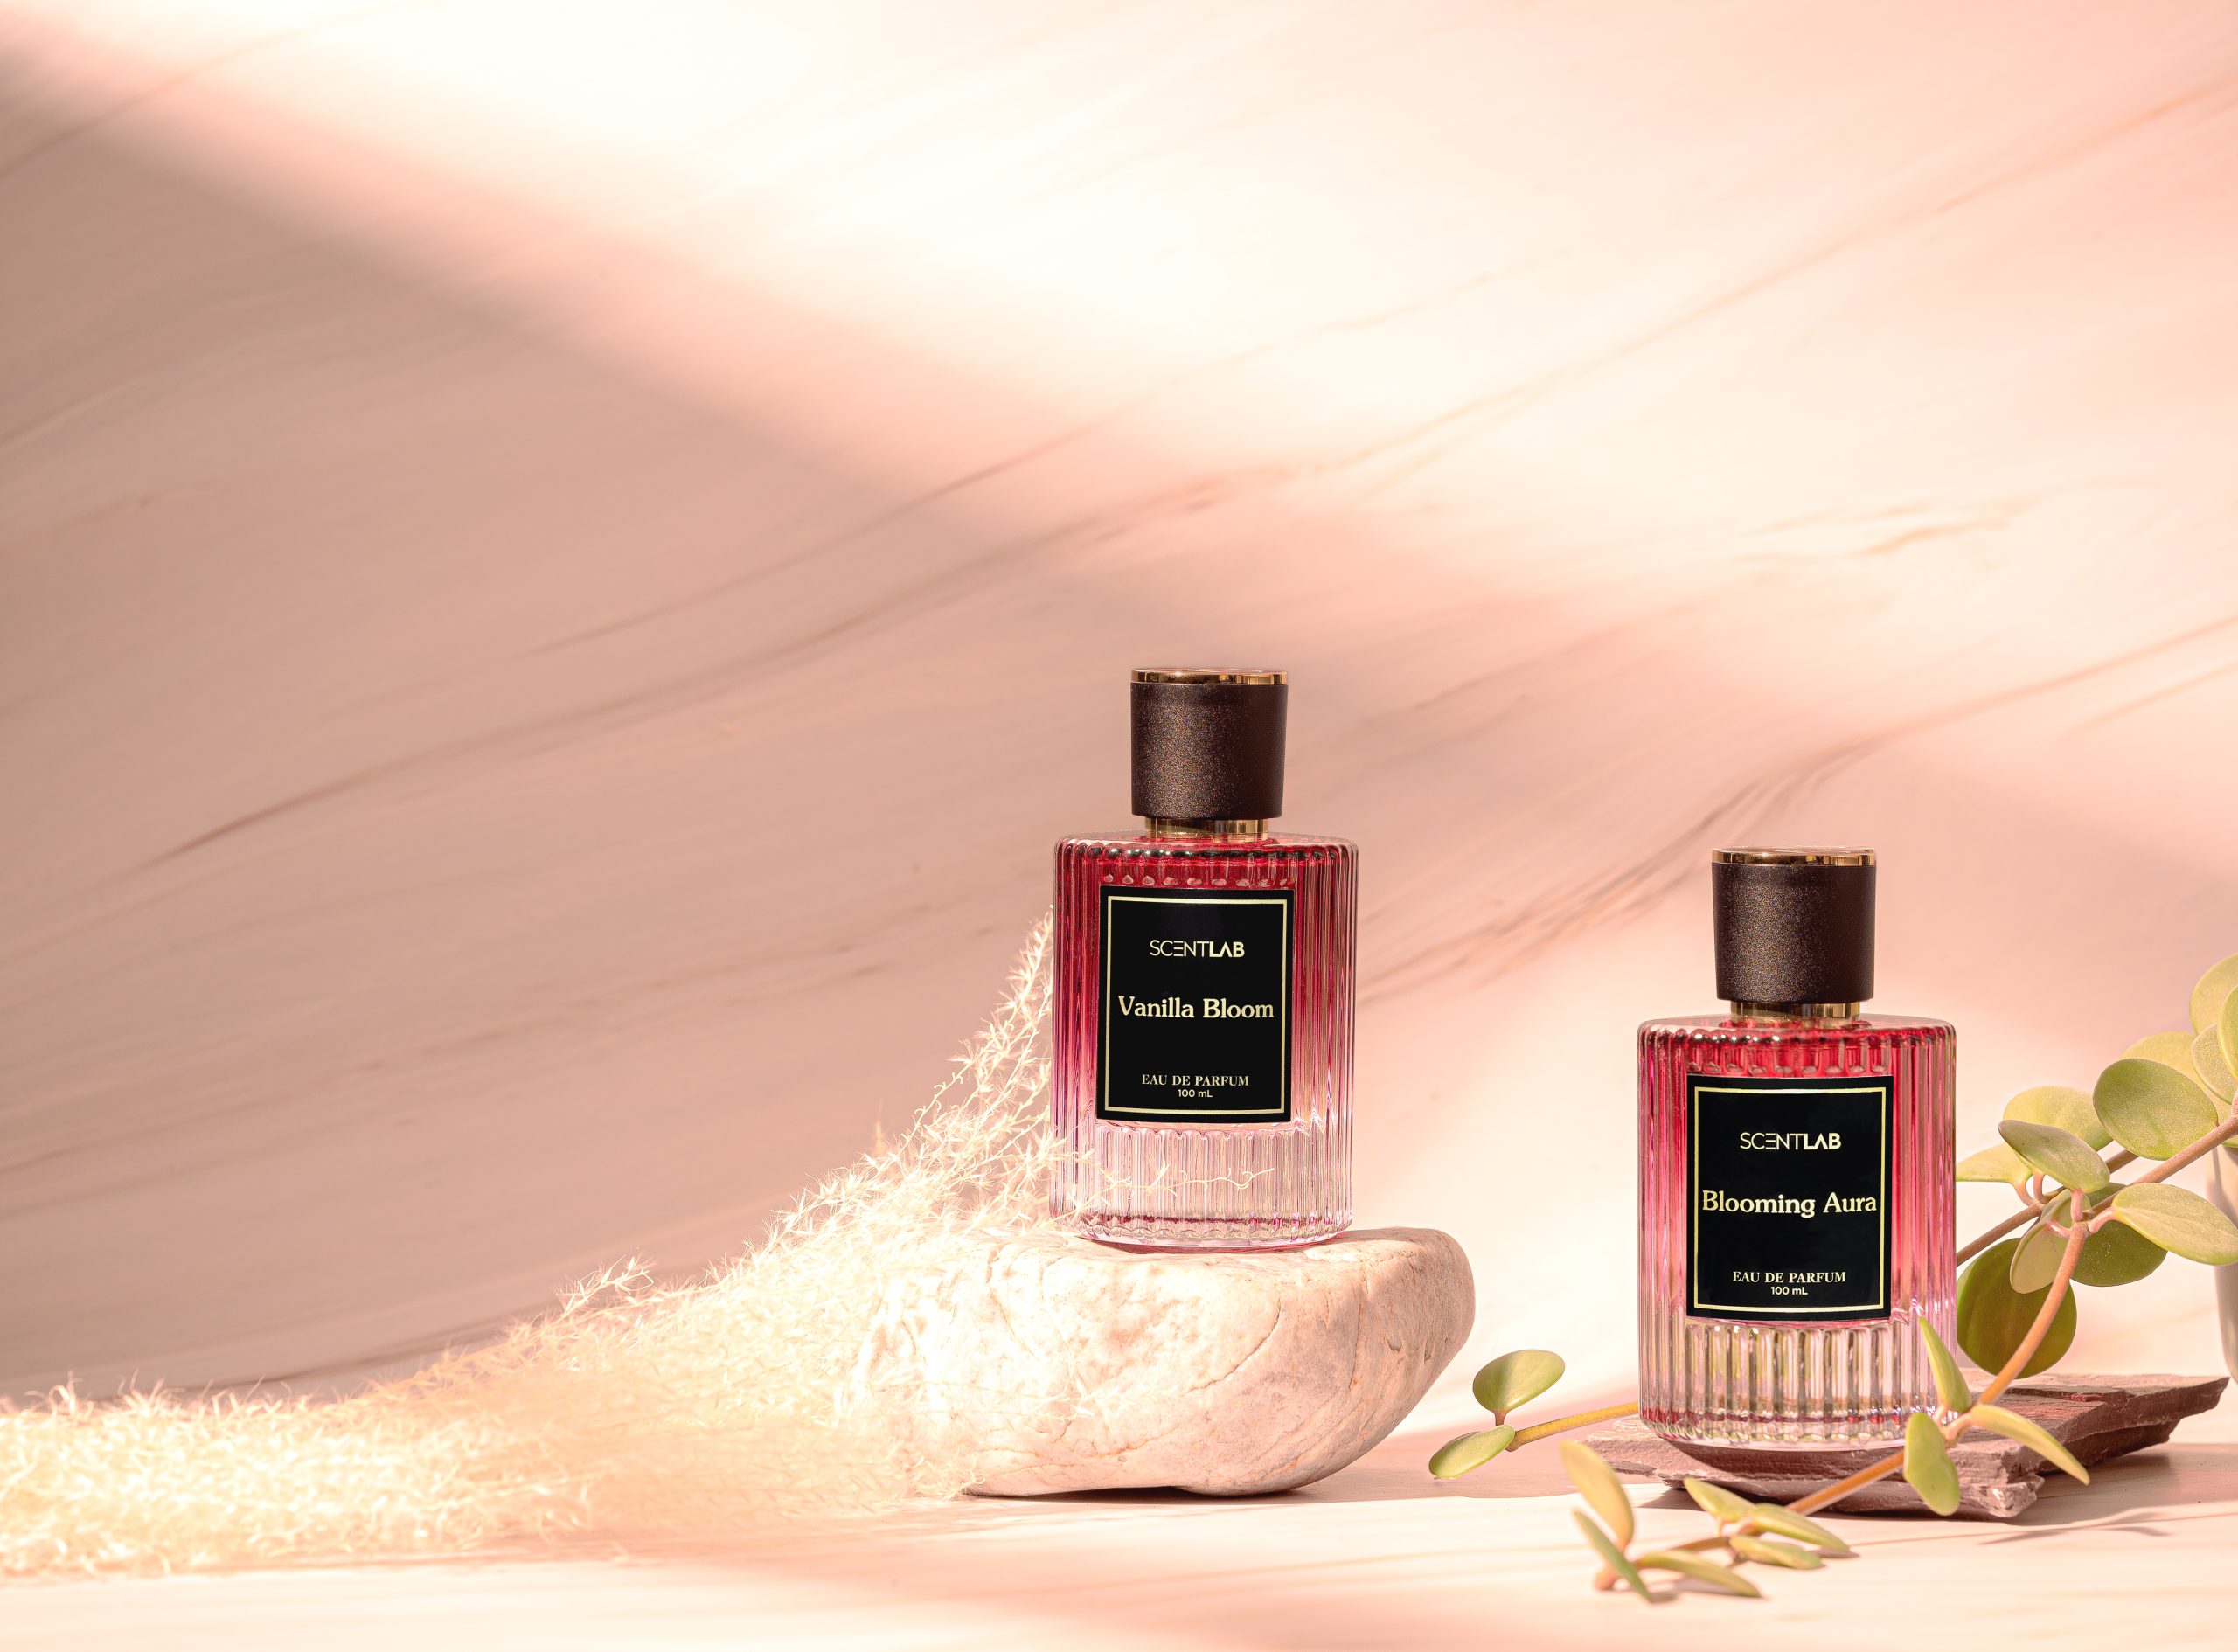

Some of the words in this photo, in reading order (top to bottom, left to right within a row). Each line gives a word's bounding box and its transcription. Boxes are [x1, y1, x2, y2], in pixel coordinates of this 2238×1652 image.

[1149, 939, 1246, 958] SCENTLAB
[1118, 995, 1195, 1018] Vanilla
[1202, 997, 1275, 1019] Bloom
[1141, 1073, 1168, 1086] EAU
[1171, 1074, 1191, 1086] DE
[1194, 1075, 1249, 1086] PARFUM
[1177, 1088, 1196, 1098] 100
[1198, 1089, 1213, 1098] mL
[1740, 1131, 1842, 1150] SCENTLAB
[1702, 1190, 1816, 1218] Blooming
[1823, 1191, 1877, 1214] Aura
[1733, 1271, 1760, 1283] EAU
[1764, 1272, 1783, 1284] DE
[1788, 1271, 1846, 1284] PARFUM
[1770, 1286, 1790, 1295] 100
[1791, 1287, 1809, 1295] mL
